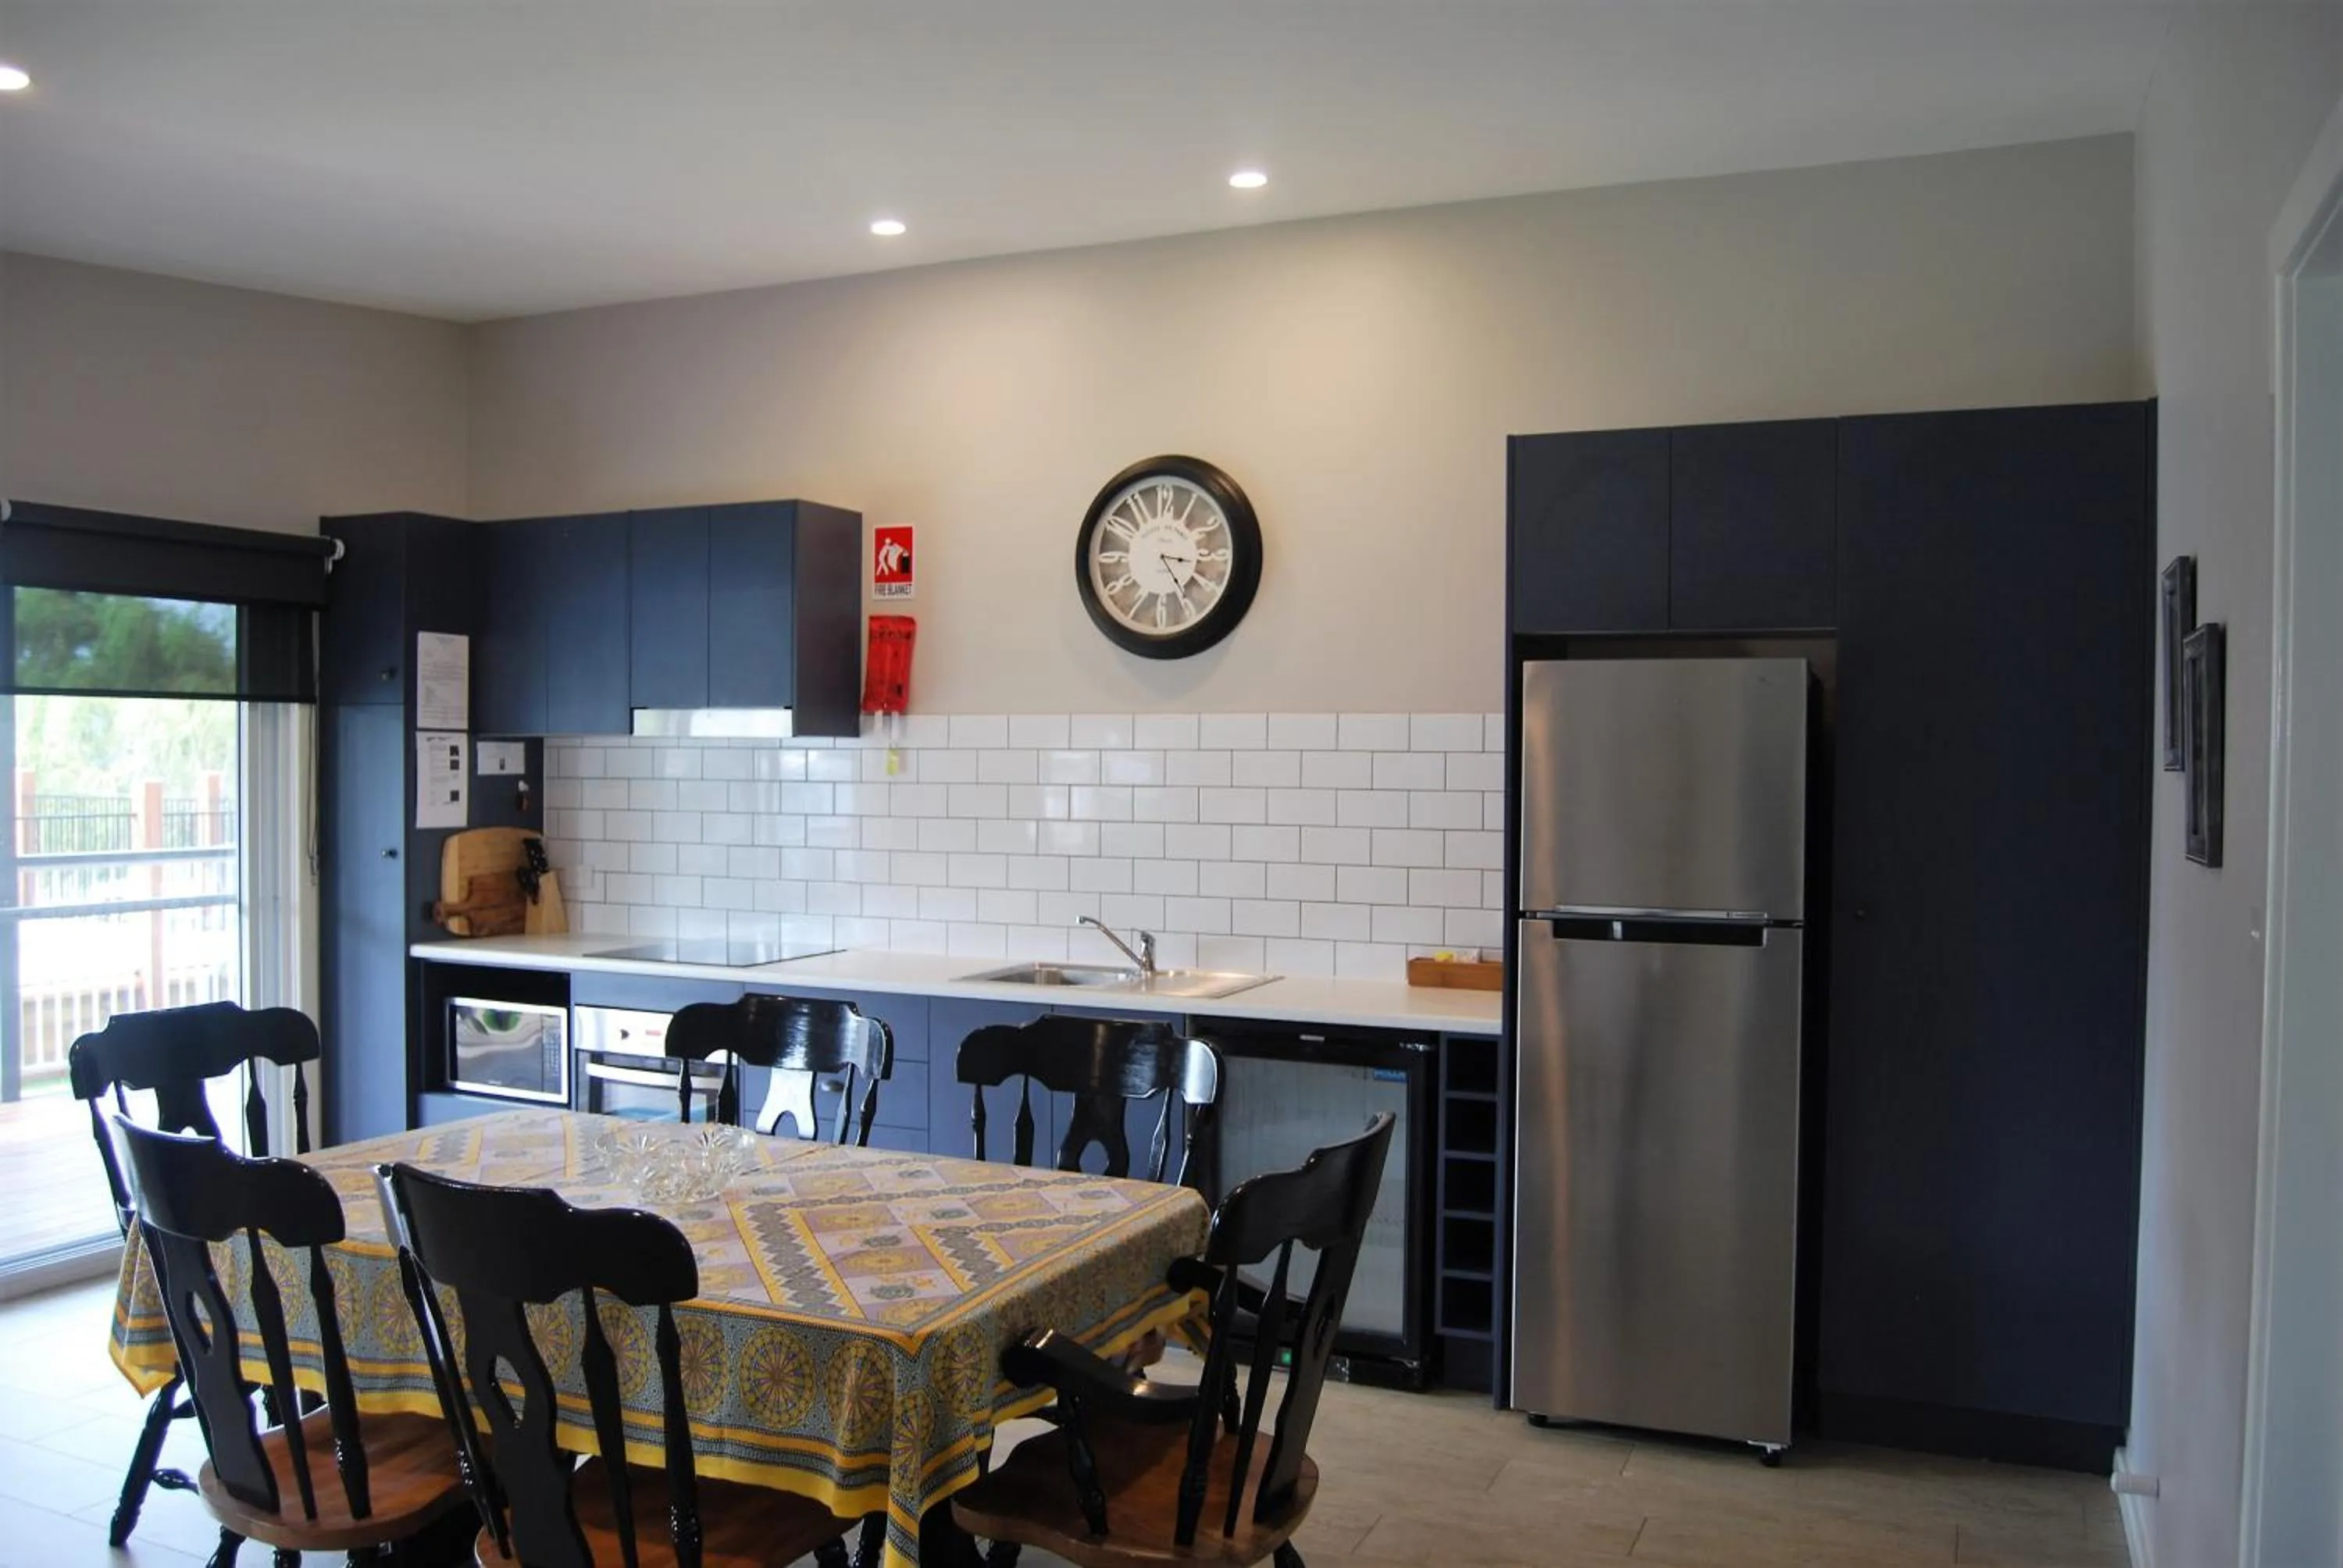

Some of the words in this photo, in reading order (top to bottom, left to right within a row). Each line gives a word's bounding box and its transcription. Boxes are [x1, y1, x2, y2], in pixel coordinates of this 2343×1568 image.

[1127, 493, 1150, 526] 11
[1157, 484, 1173, 519] 12
[1181, 493, 1196, 523] 1
[1105, 517, 1137, 539] 10
[1191, 518, 1219, 540] 2
[1100, 551, 1129, 563] 9
[1197, 548, 1228, 561] 3
[875, 584, 886, 596] FIRE
[888, 583, 912, 595] BLANKET
[1106, 575, 1133, 593] 8
[1129, 592, 1147, 619] 7
[1157, 595, 1165, 628] 6
